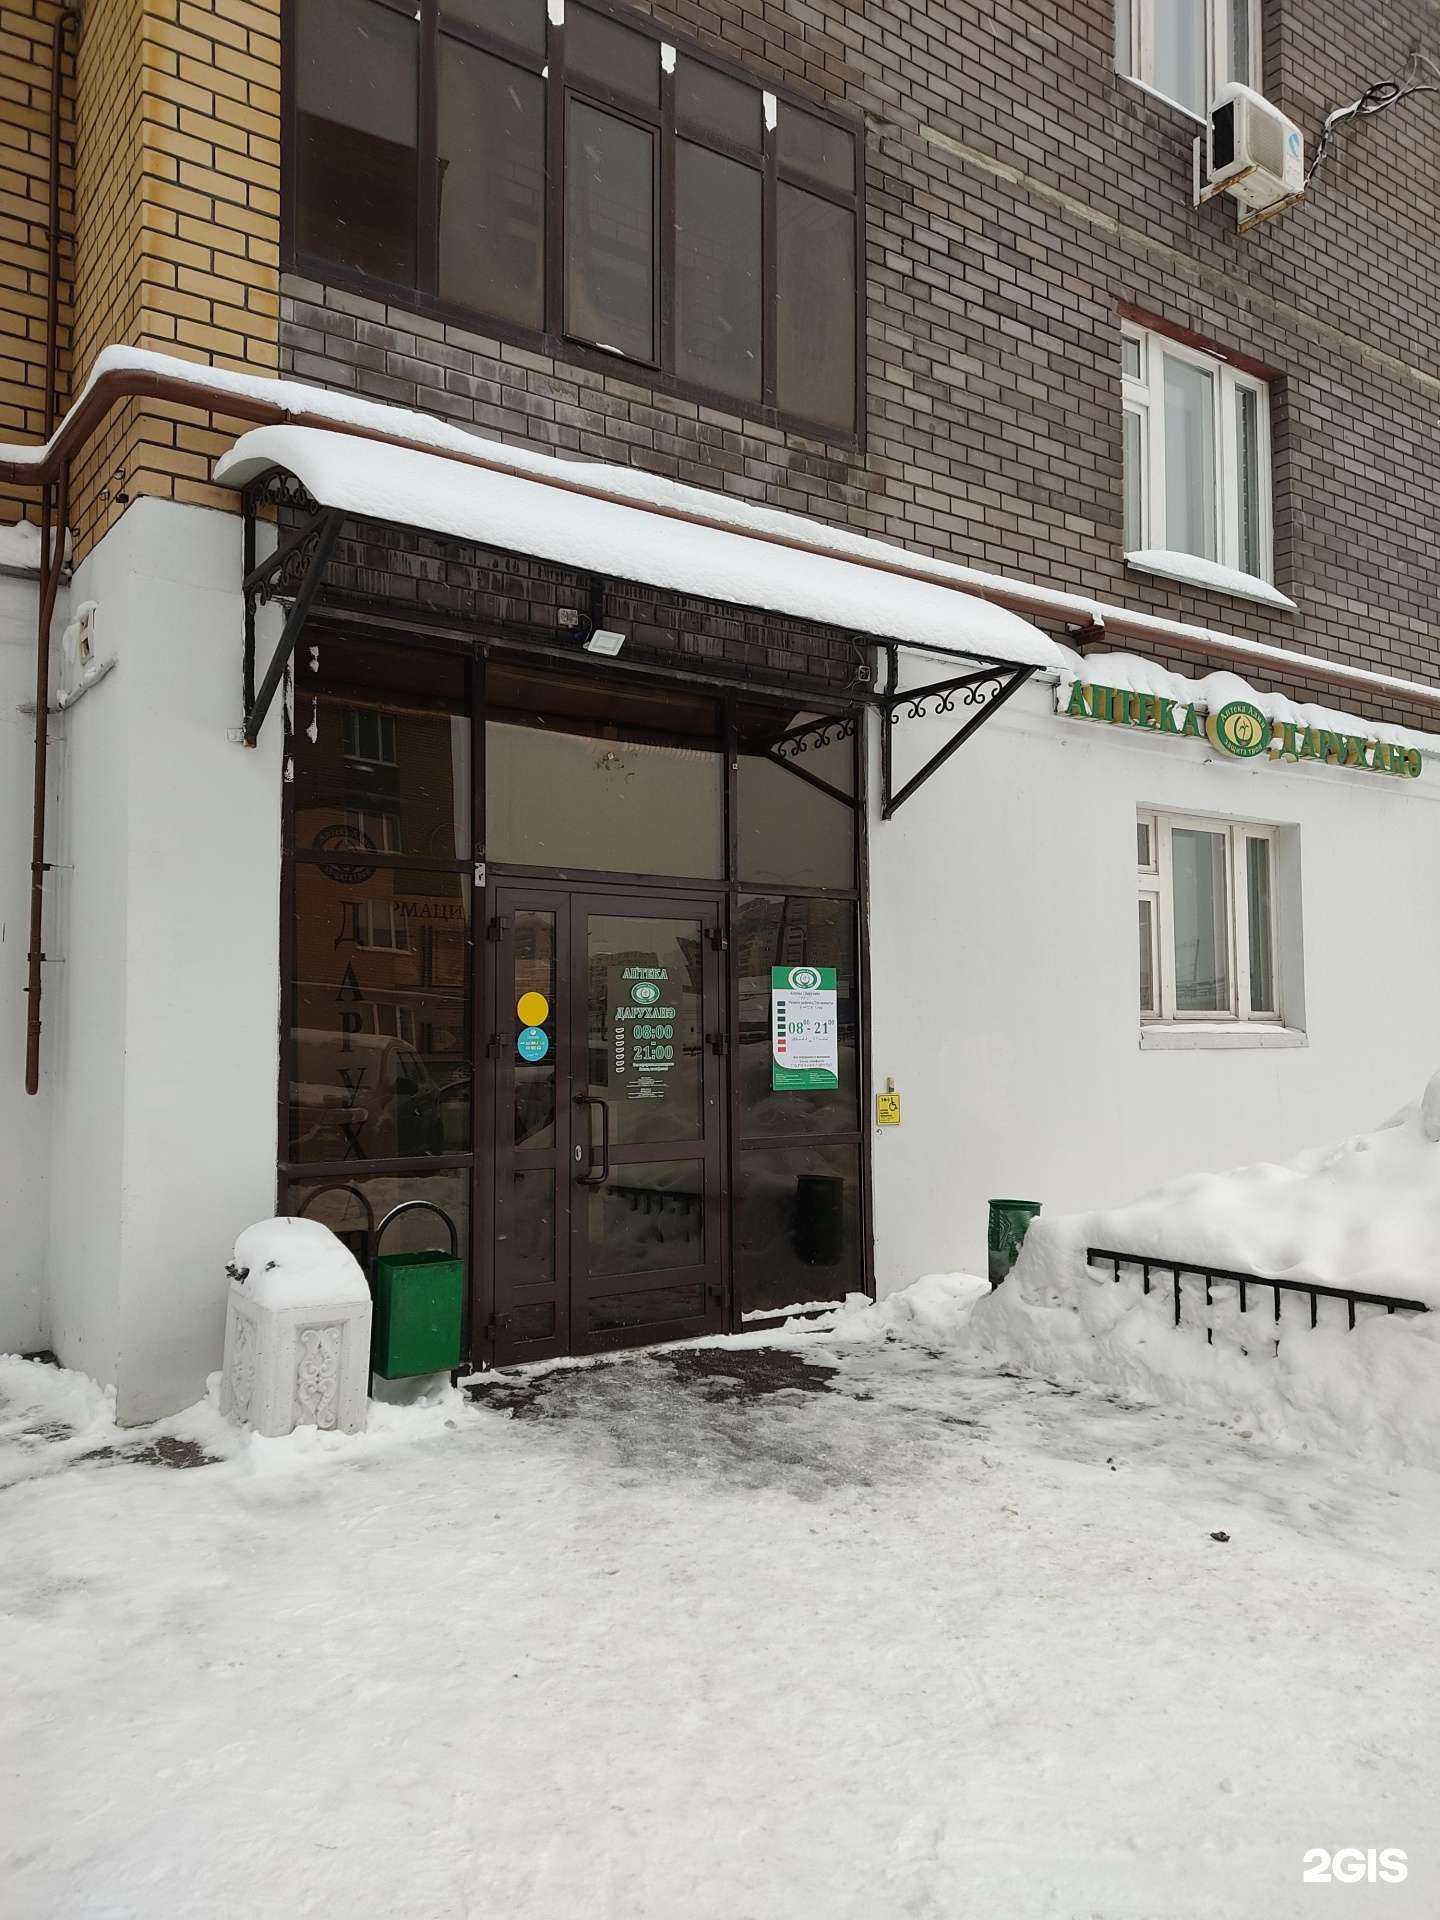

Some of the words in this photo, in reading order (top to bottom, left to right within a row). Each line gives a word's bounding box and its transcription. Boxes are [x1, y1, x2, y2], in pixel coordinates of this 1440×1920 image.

[1065, 680, 1201, 738] АПТЕКА
[622, 967, 669, 980] АПТЕКА
[633, 1025, 674, 1040] 08:00
[633, 1045, 674, 1060] 21:00
